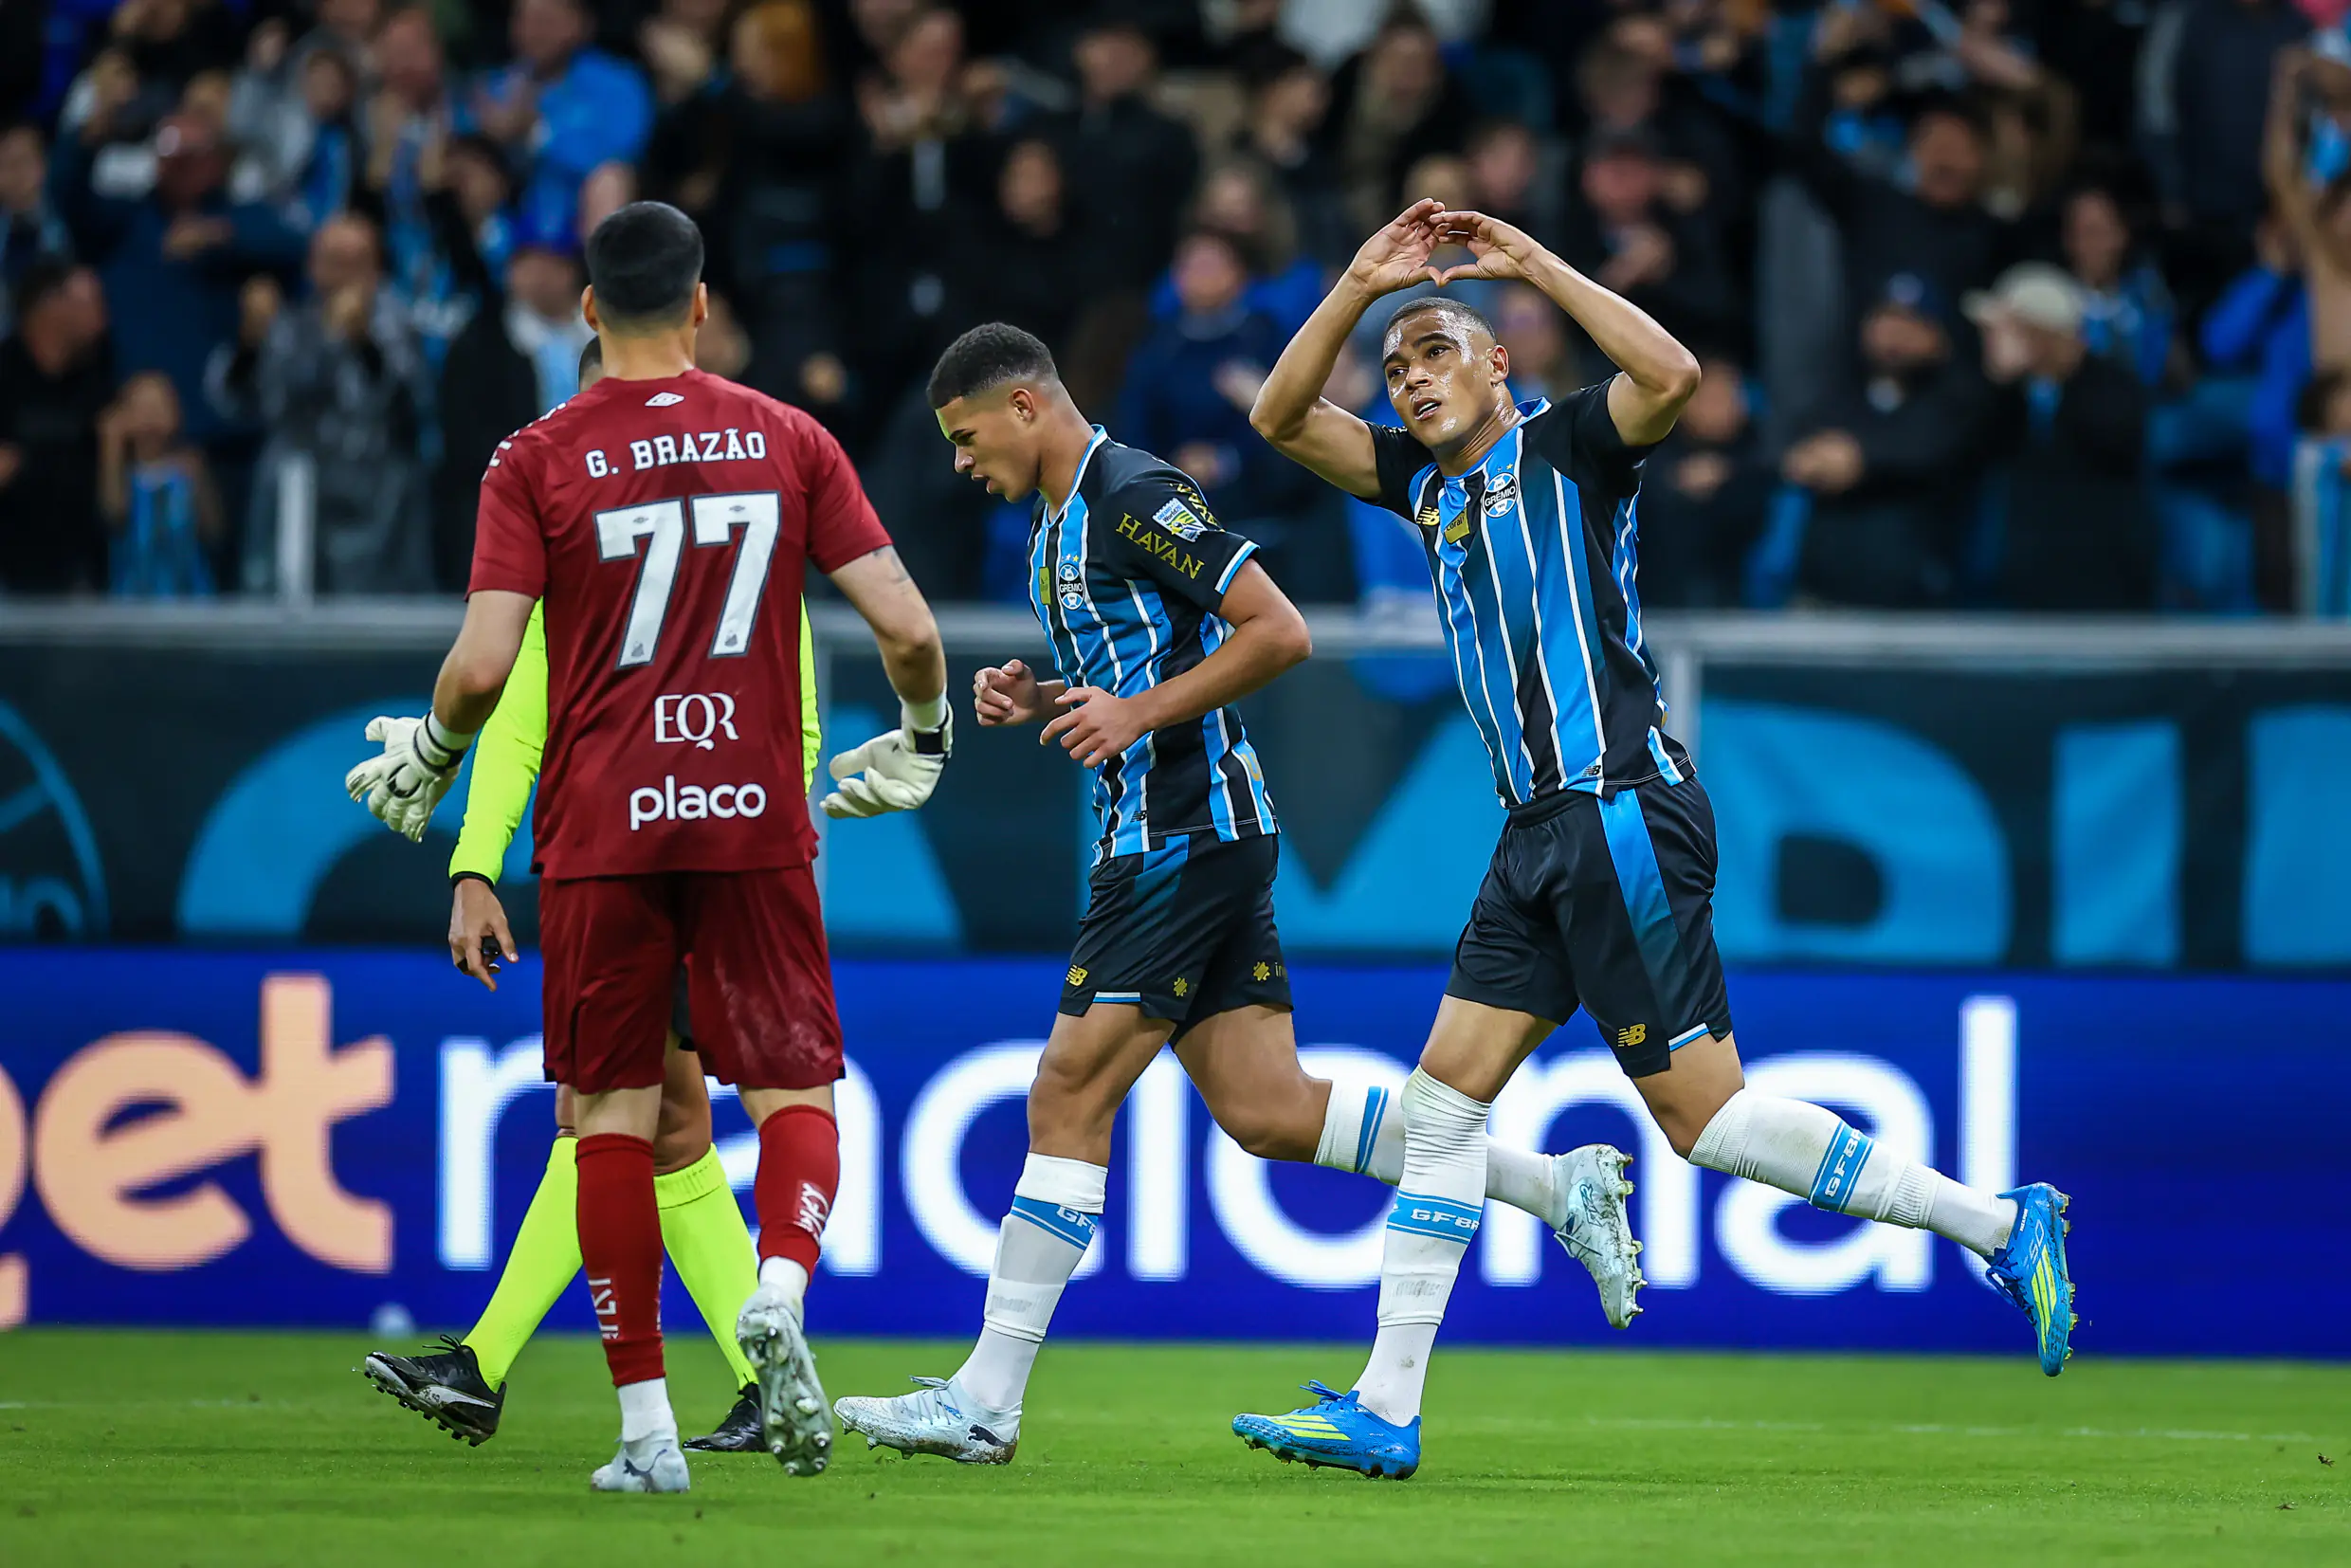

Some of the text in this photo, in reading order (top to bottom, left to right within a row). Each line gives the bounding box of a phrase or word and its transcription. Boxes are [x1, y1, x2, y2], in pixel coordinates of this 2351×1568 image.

[585, 428, 766, 480] G. BRAZÃO
[1485, 485, 1516, 506] GRÊMIO
[1116, 512, 1205, 580] HAVAN
[593, 491, 780, 669] 77
[1059, 580, 1084, 593] GRÊMIO
[654, 691, 739, 751] EQR
[629, 775, 767, 831] placo
